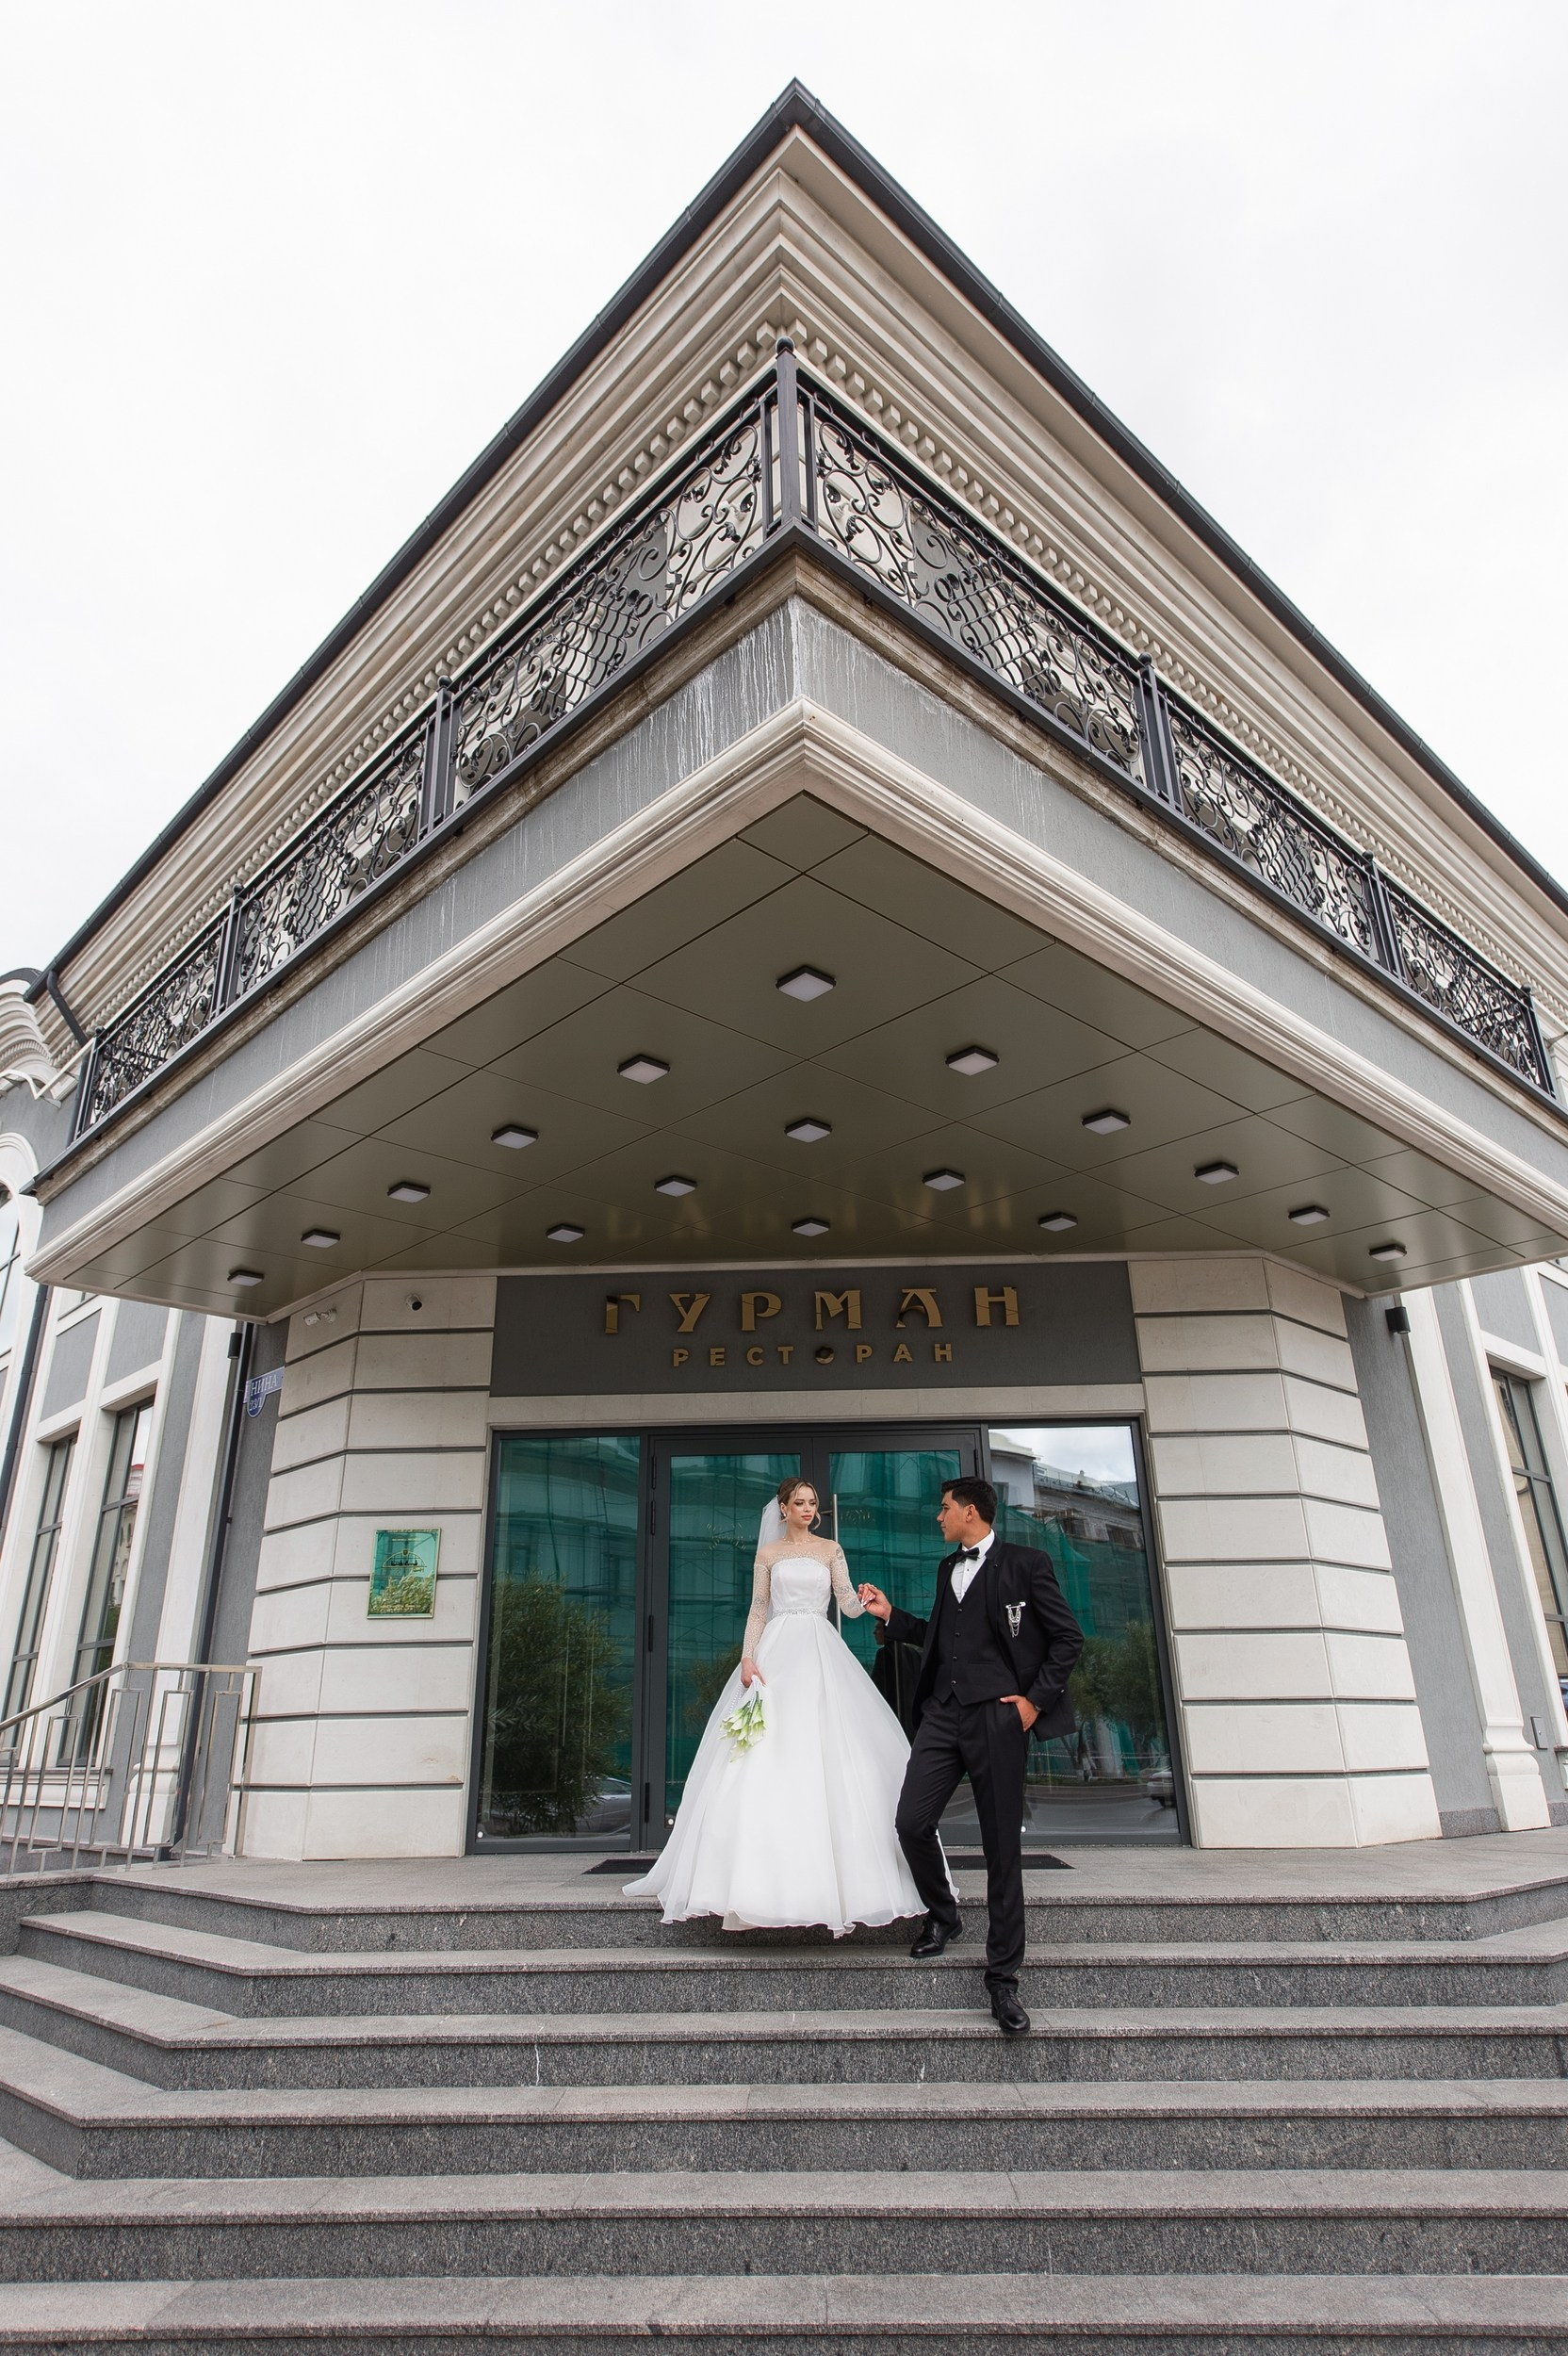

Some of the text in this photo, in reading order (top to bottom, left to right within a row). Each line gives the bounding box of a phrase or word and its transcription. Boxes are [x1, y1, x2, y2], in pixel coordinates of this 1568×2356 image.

[604, 1286, 1021, 1334] ГУРМАН
[673, 1343, 953, 1367] РЕСТОРАН
[249, 1374, 277, 1397] НИНА
